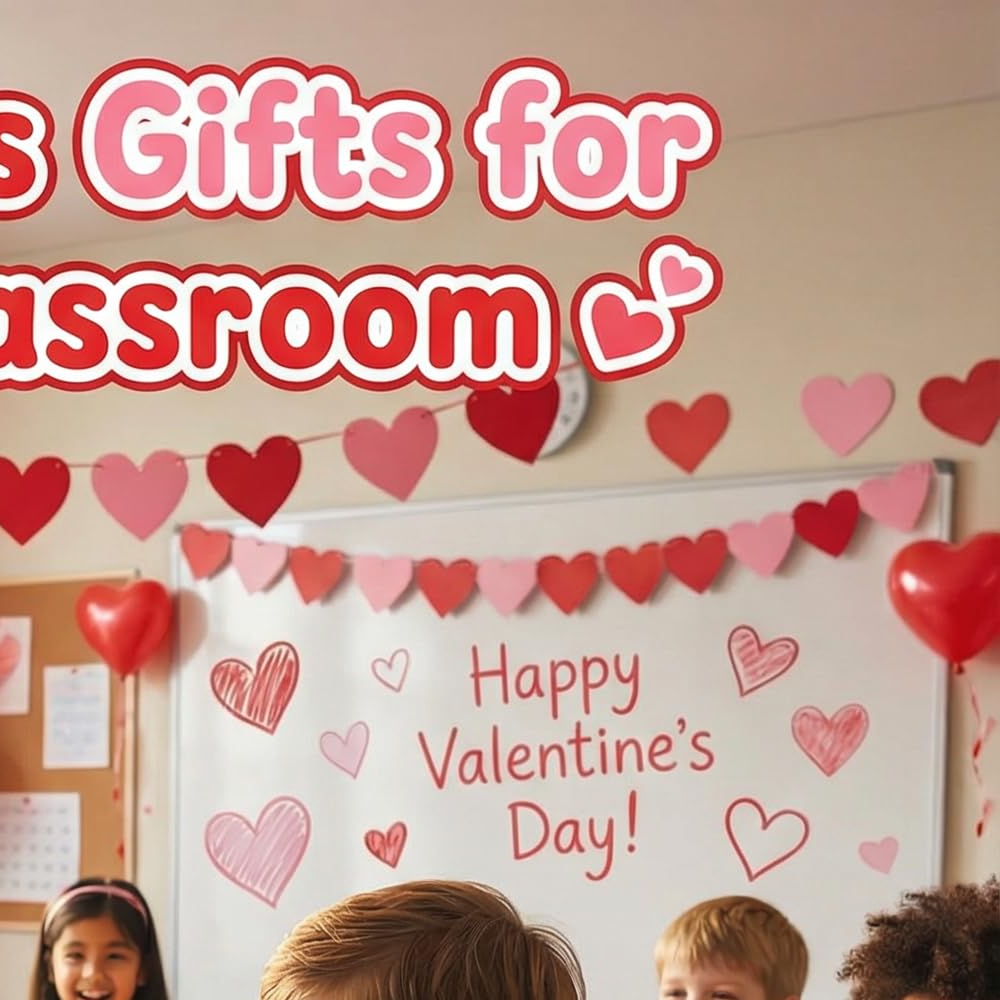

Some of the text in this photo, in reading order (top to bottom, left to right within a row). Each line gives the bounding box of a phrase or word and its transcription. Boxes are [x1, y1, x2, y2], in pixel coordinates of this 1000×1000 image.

[469, 642, 640, 720] Happy
[417, 716, 715, 790] Valentine's
[507, 789, 637, 882] Day!
